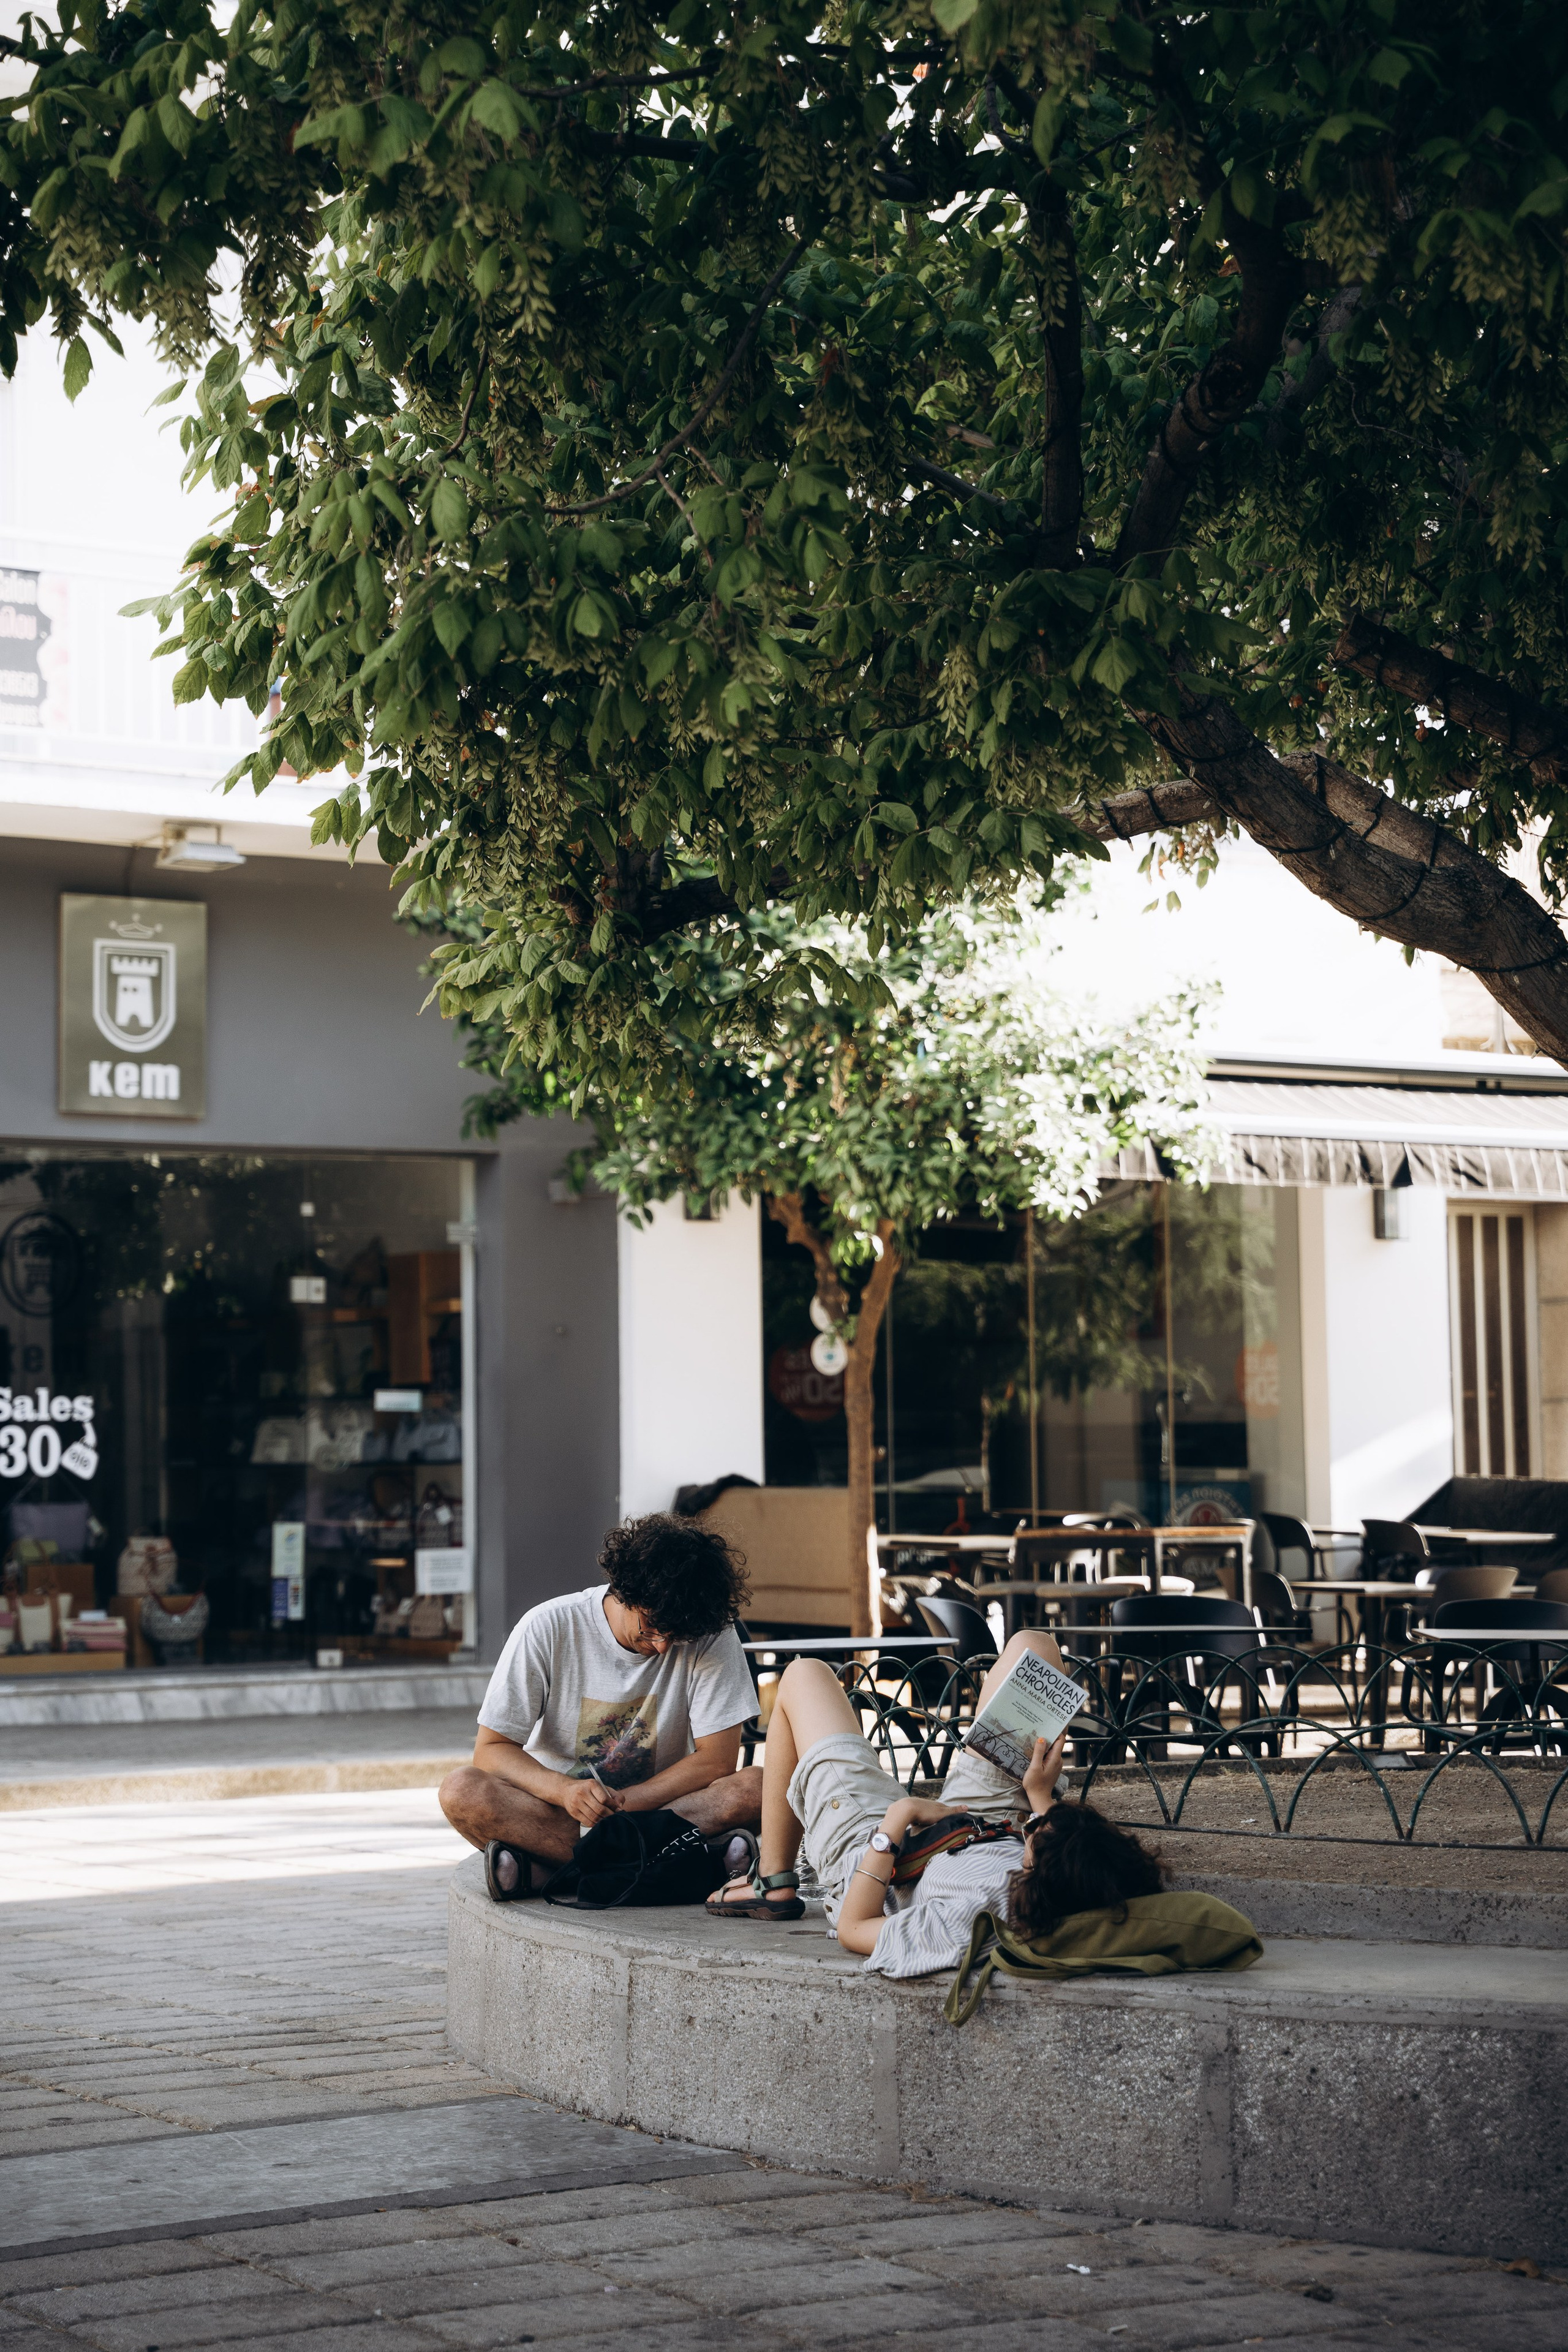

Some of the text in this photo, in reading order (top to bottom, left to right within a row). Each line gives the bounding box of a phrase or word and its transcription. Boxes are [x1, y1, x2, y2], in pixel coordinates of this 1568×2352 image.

[1009, 1678, 1027, 1692] ANNA
[1027, 1691, 1046, 1706] MARIA
[1046, 1704, 1068, 1722] ORTESE
[1016, 1667, 1076, 1715] CHRONICLES
[1020, 1654, 1085, 1705] NEAPOLITAN
